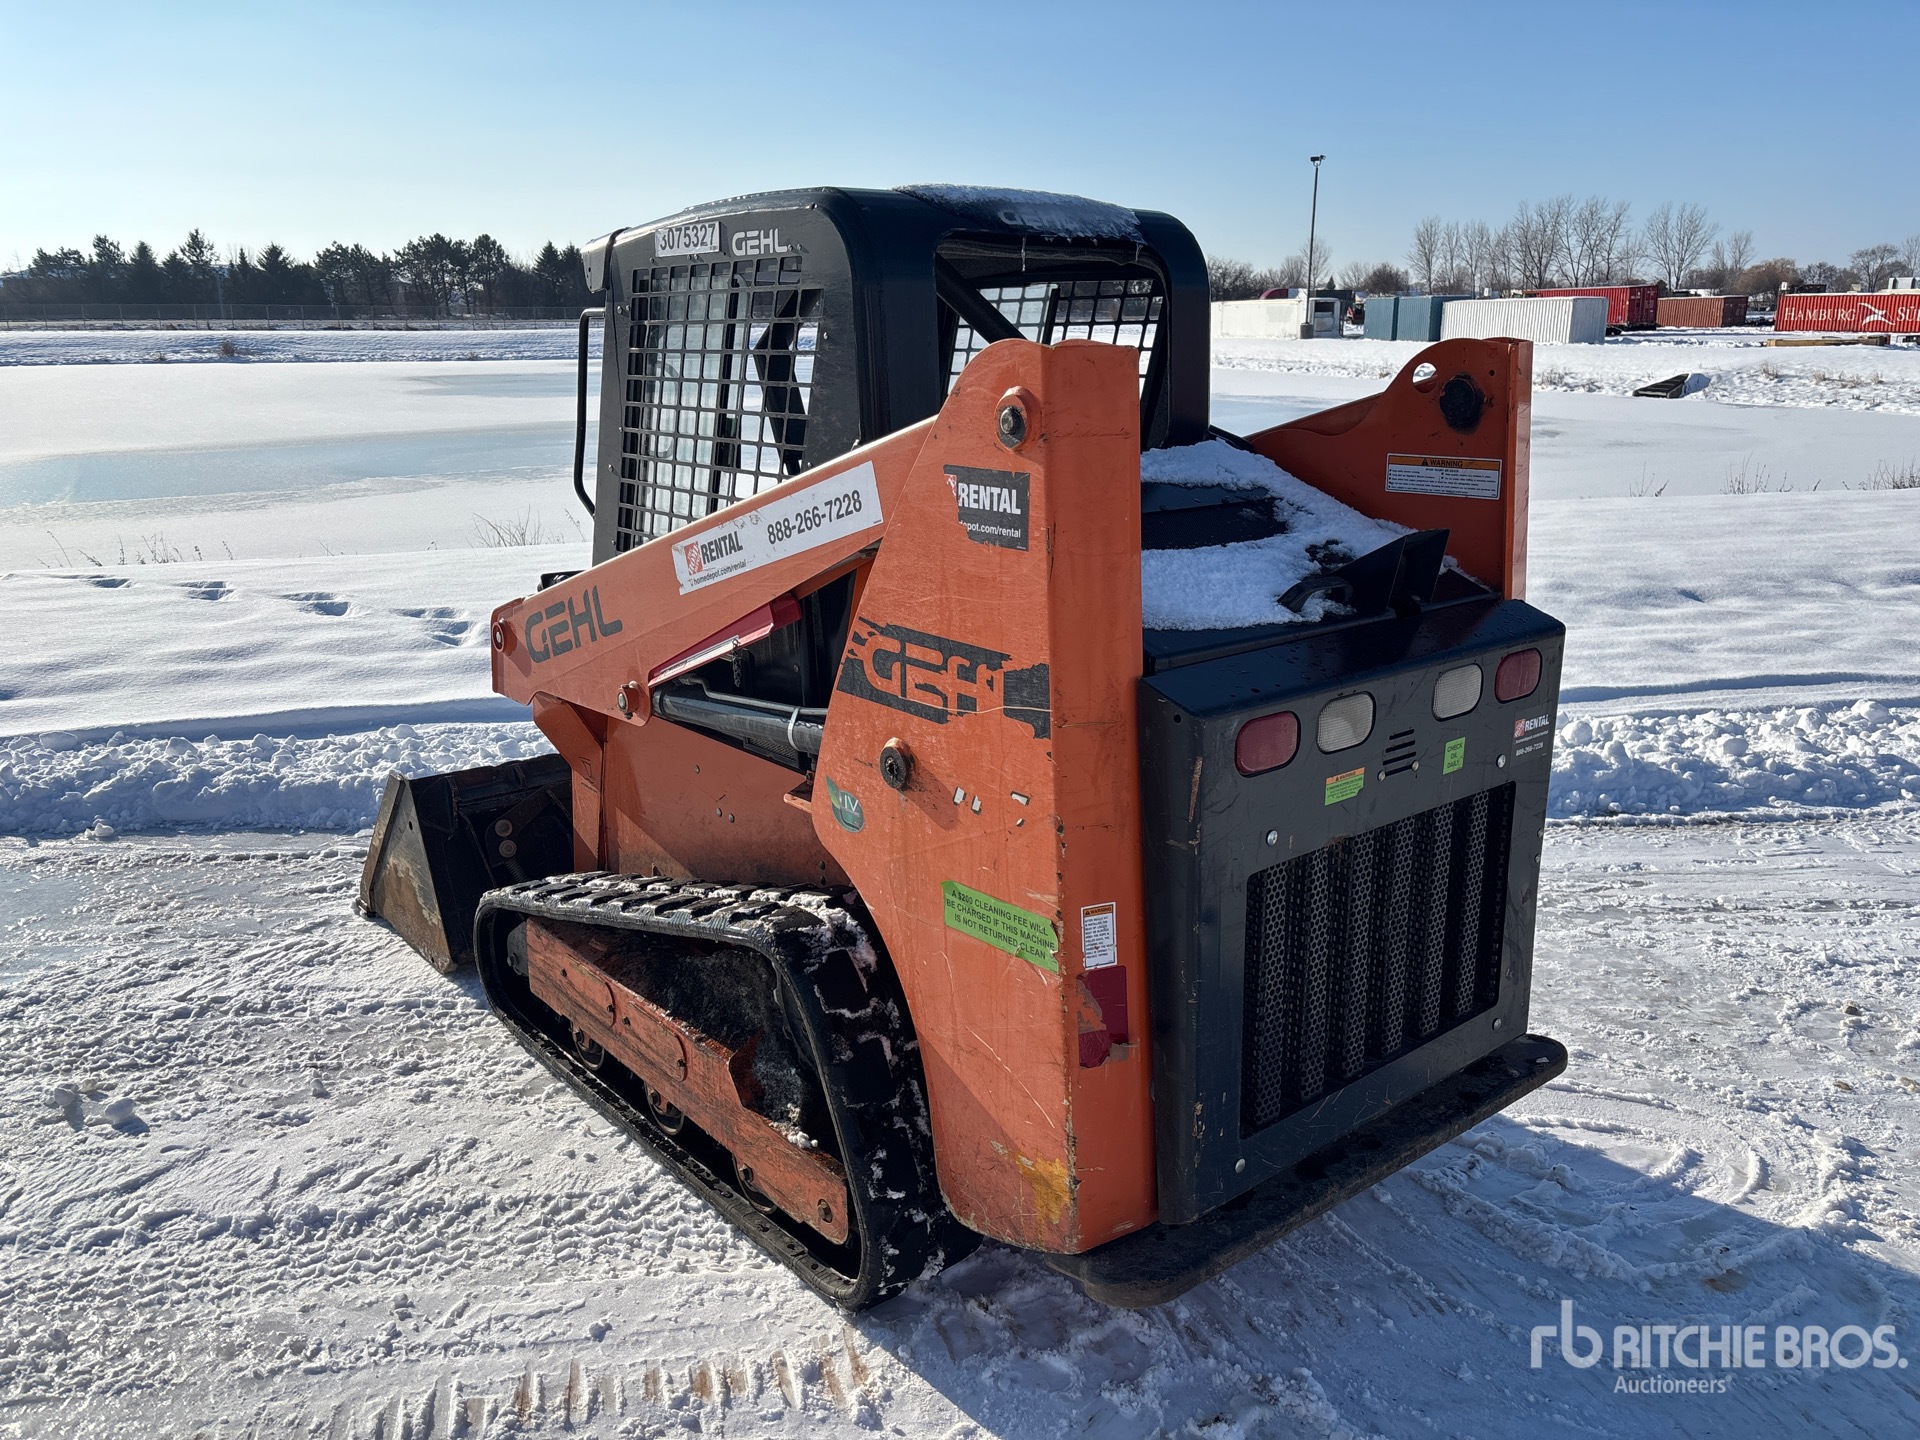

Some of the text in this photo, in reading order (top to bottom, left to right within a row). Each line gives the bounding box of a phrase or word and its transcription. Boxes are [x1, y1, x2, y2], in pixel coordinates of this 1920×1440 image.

[660, 223, 716, 250] 3075327
[731, 228, 788, 256] GEHL
[1784, 307, 1856, 321] HAMBURG
[1429, 459, 1464, 468] WARNING
[957, 483, 1022, 515] RENTAL
[767, 489, 862, 545] 888-266-7228
[700, 530, 744, 565] RENTAL
[524, 584, 623, 664] GEHL
[1524, 714, 1550, 732] RENTAL
[1447, 743, 1463, 752] CHECK
[946, 898, 1055, 951] BE CHARGED IF THIS MACHINE
[951, 889, 1049, 937] A $200 CLEANING FEE WILL
[954, 913, 1046, 960] IS NOT RETURNED CLEAN
